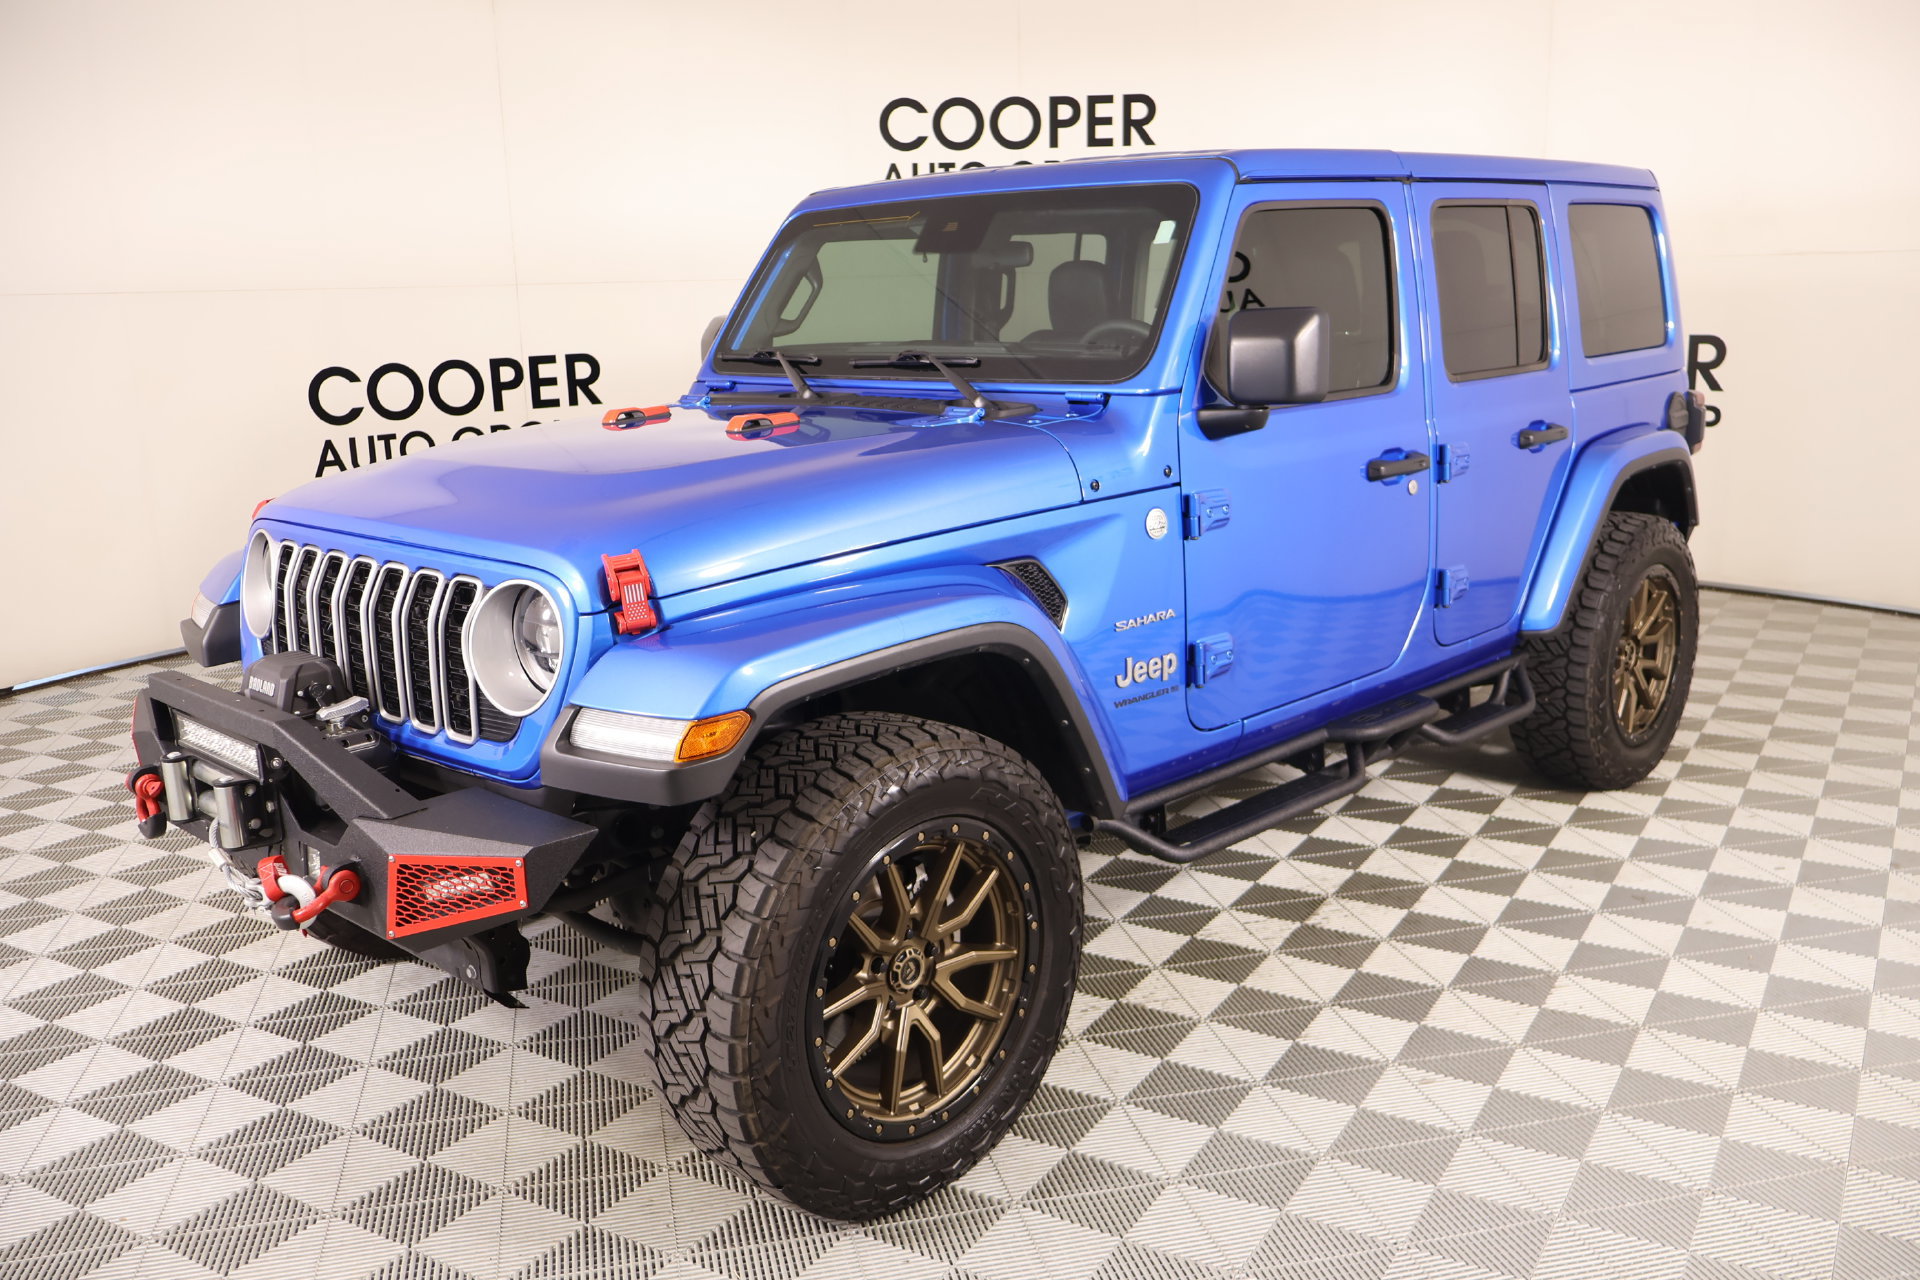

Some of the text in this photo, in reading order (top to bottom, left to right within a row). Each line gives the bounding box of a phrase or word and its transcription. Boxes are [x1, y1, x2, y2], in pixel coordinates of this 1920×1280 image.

[880, 93, 1156, 151] COOPER
[308, 353, 603, 426] COOPER
[1114, 608, 1176, 632] SAHARA
[1115, 651, 1179, 688] Jeep
[1113, 687, 1170, 709] WRANGLER
